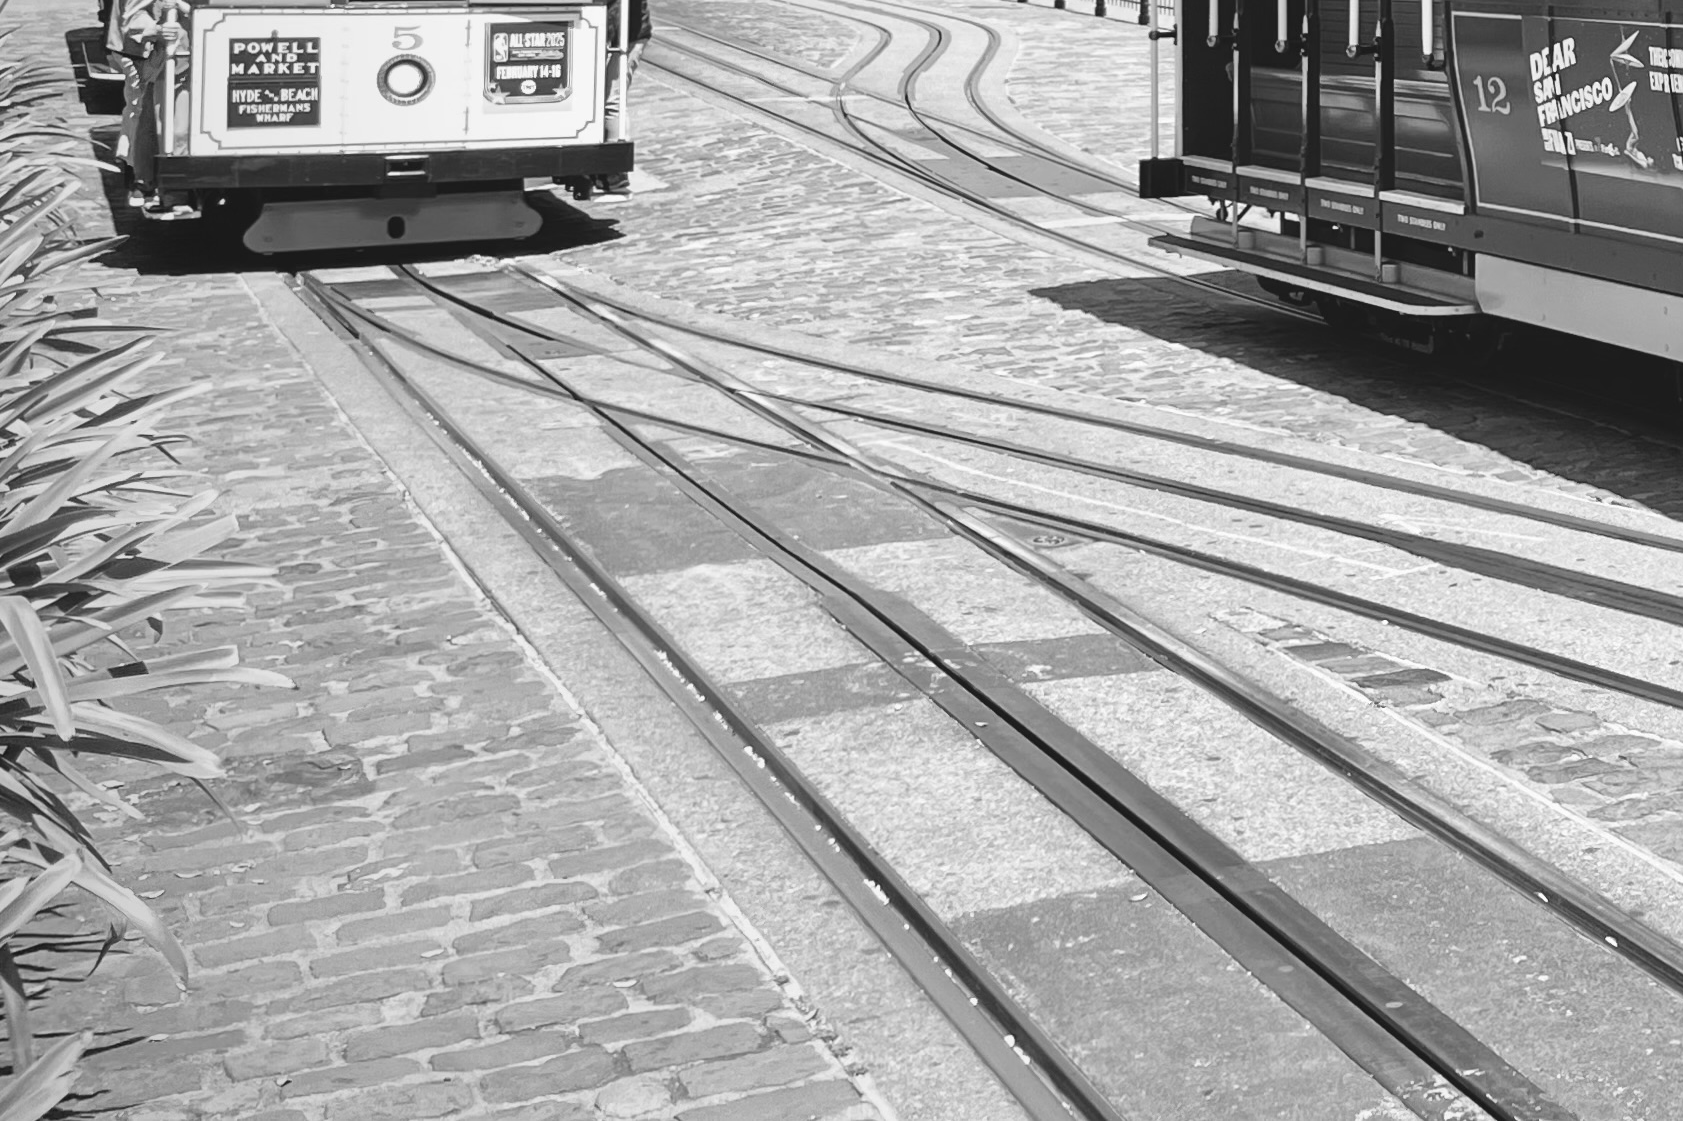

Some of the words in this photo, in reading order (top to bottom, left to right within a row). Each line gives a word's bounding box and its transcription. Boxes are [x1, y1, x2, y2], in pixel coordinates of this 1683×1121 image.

[392, 25, 424, 50] 5
[546, 31, 566, 47] 2025
[233, 41, 319, 54] POWELL
[255, 53, 298, 63] AND
[1529, 37, 1577, 81] DEAR
[231, 62, 320, 74] MARKET
[496, 65, 539, 80] FEBRUARY
[540, 64, 562, 79] 14-16
[232, 88, 262, 103] HYDE
[280, 87, 319, 101] BEACH
[1473, 75, 1511, 115] 12
[1537, 77, 1613, 128] FRANCISCO
[238, 103, 311, 115] FISHERMANS
[256, 113, 294, 123] WHARF
